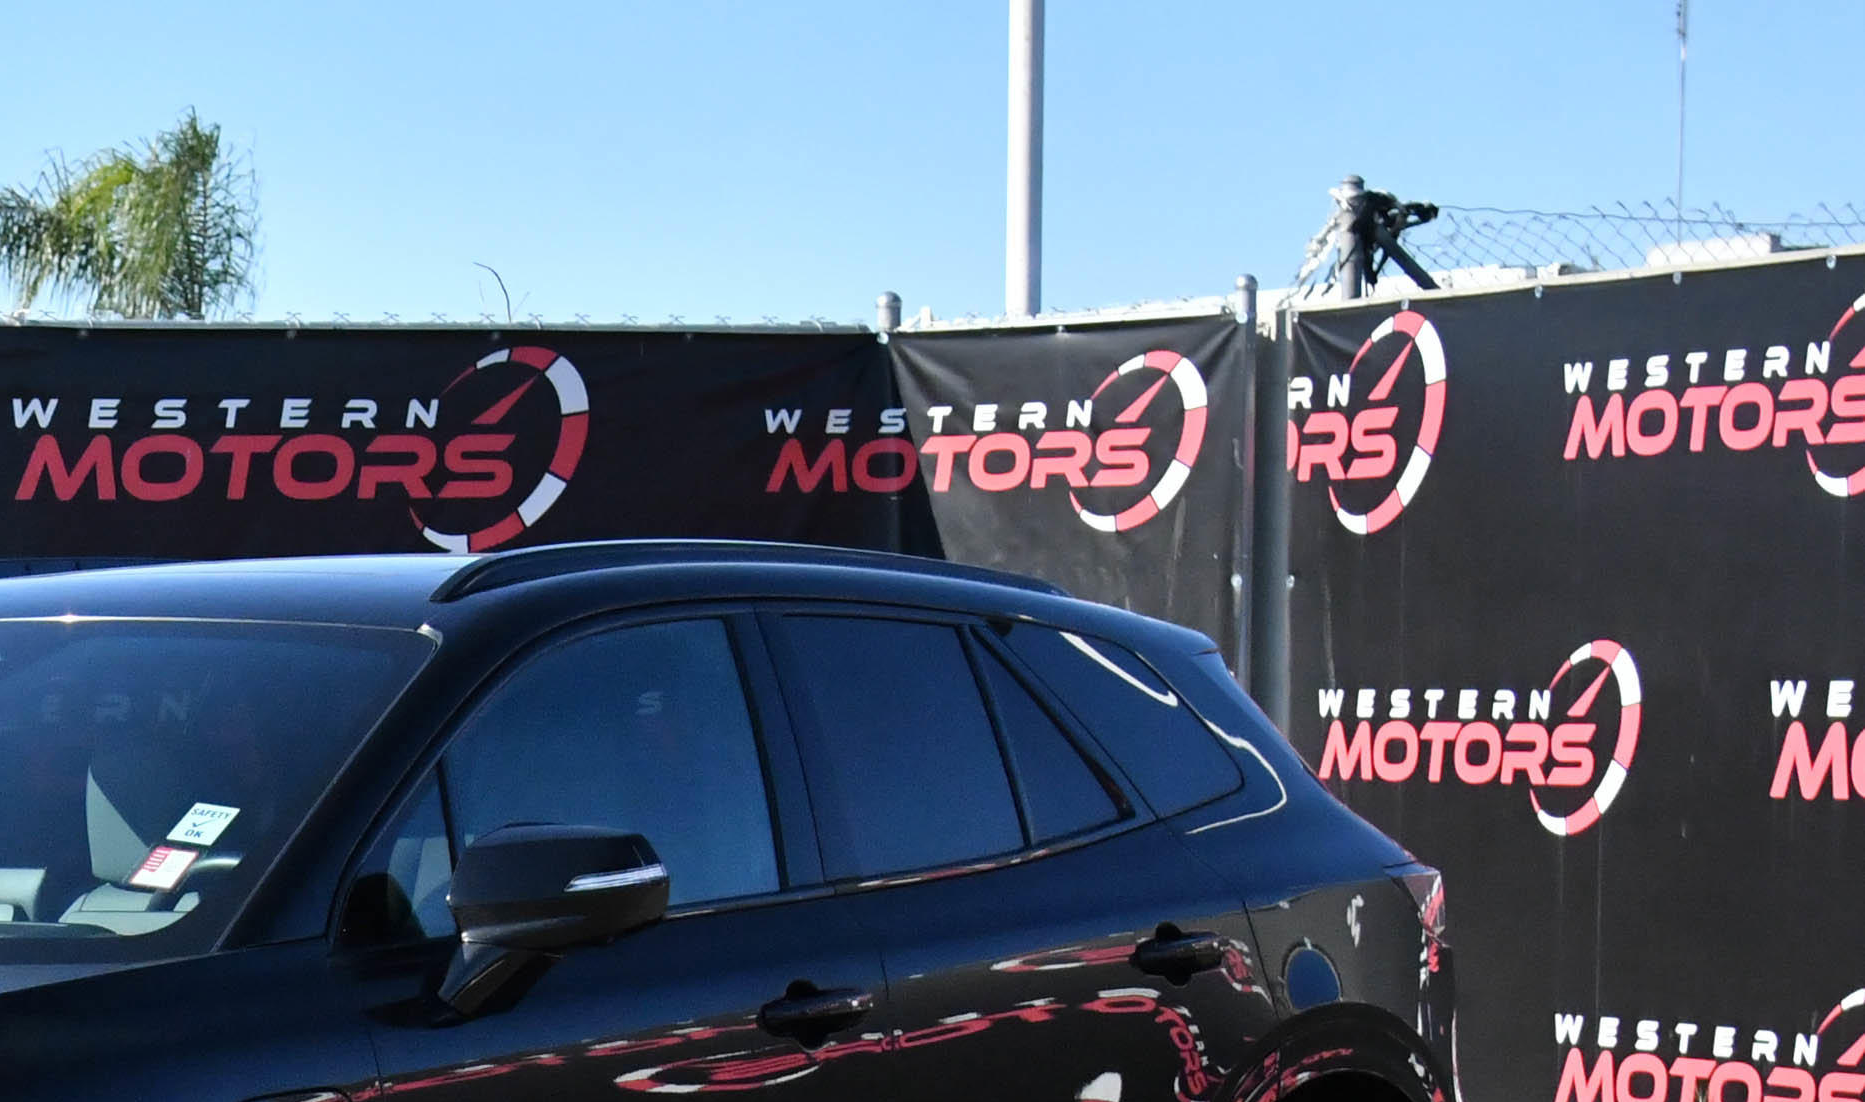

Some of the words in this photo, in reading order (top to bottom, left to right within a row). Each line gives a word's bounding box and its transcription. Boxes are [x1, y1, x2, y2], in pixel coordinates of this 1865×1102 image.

[1563, 340, 1831, 395] WESTERN
[12, 398, 439, 429] WESTERN
[765, 398, 1093, 434] WESTERN
[15, 434, 515, 502] MOTORS
[766, 426, 1152, 493] MOTORS
[1318, 688, 1552, 721] WESTERN
[1316, 719, 1599, 788] MOTORS
[1769, 719, 1865, 801] M
[185, 829, 204, 838] OK
[191, 808, 232, 820] SAFETY
[1554, 1012, 1819, 1067] WESTERN
